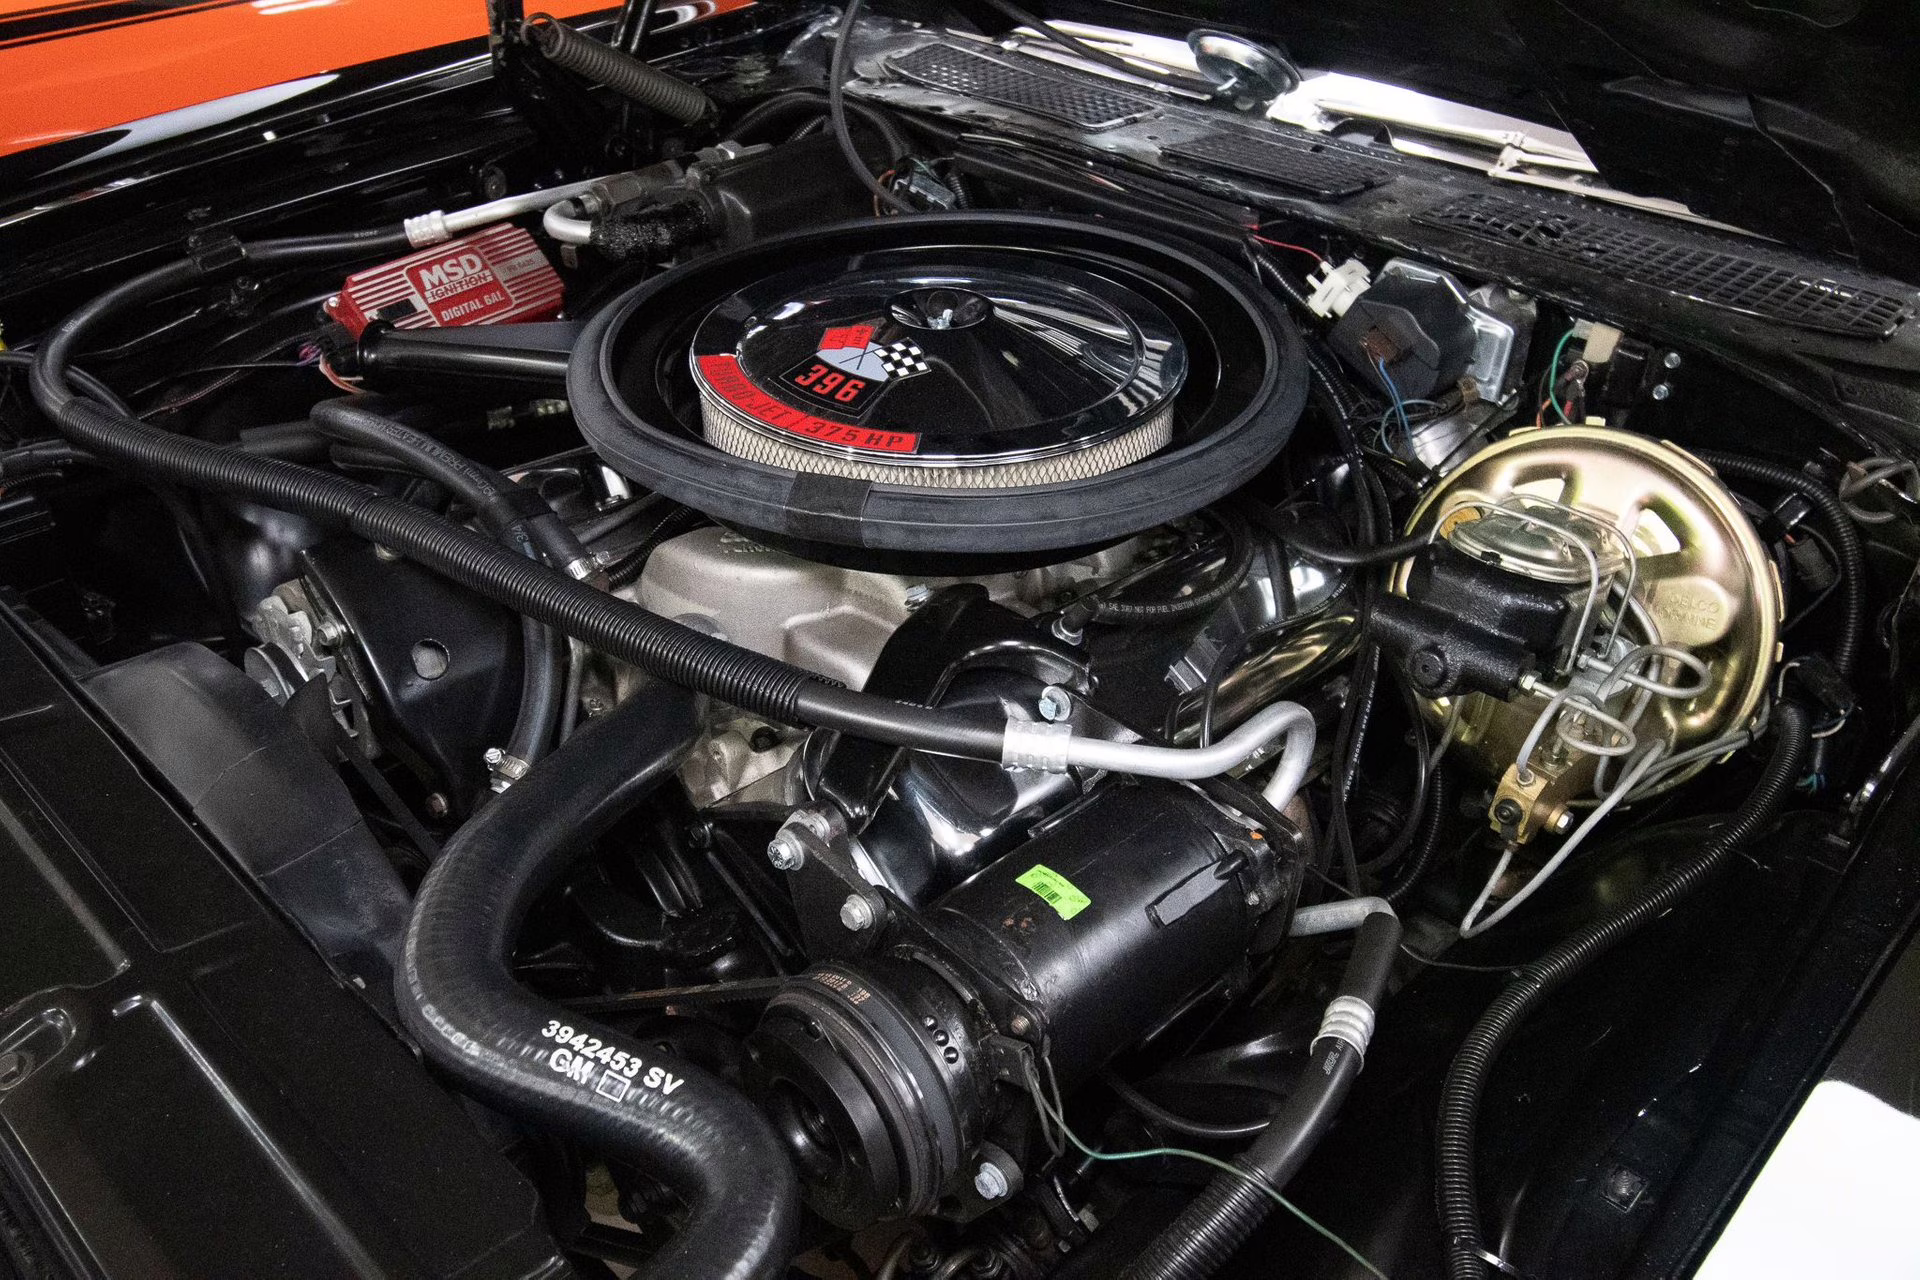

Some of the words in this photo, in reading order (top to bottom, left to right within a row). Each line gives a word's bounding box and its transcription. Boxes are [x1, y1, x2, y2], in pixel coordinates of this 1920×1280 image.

[419, 253, 482, 290] MSD
[430, 271, 490, 300] IGNITION
[441, 298, 483, 321] DIGITAL
[795, 363, 867, 402] 396
[804, 421, 857, 443] 375
[864, 432, 905, 448] HP
[541, 1020, 643, 1078] 3942453
[643, 1066, 684, 1095] SV
[549, 1048, 596, 1085] GM
